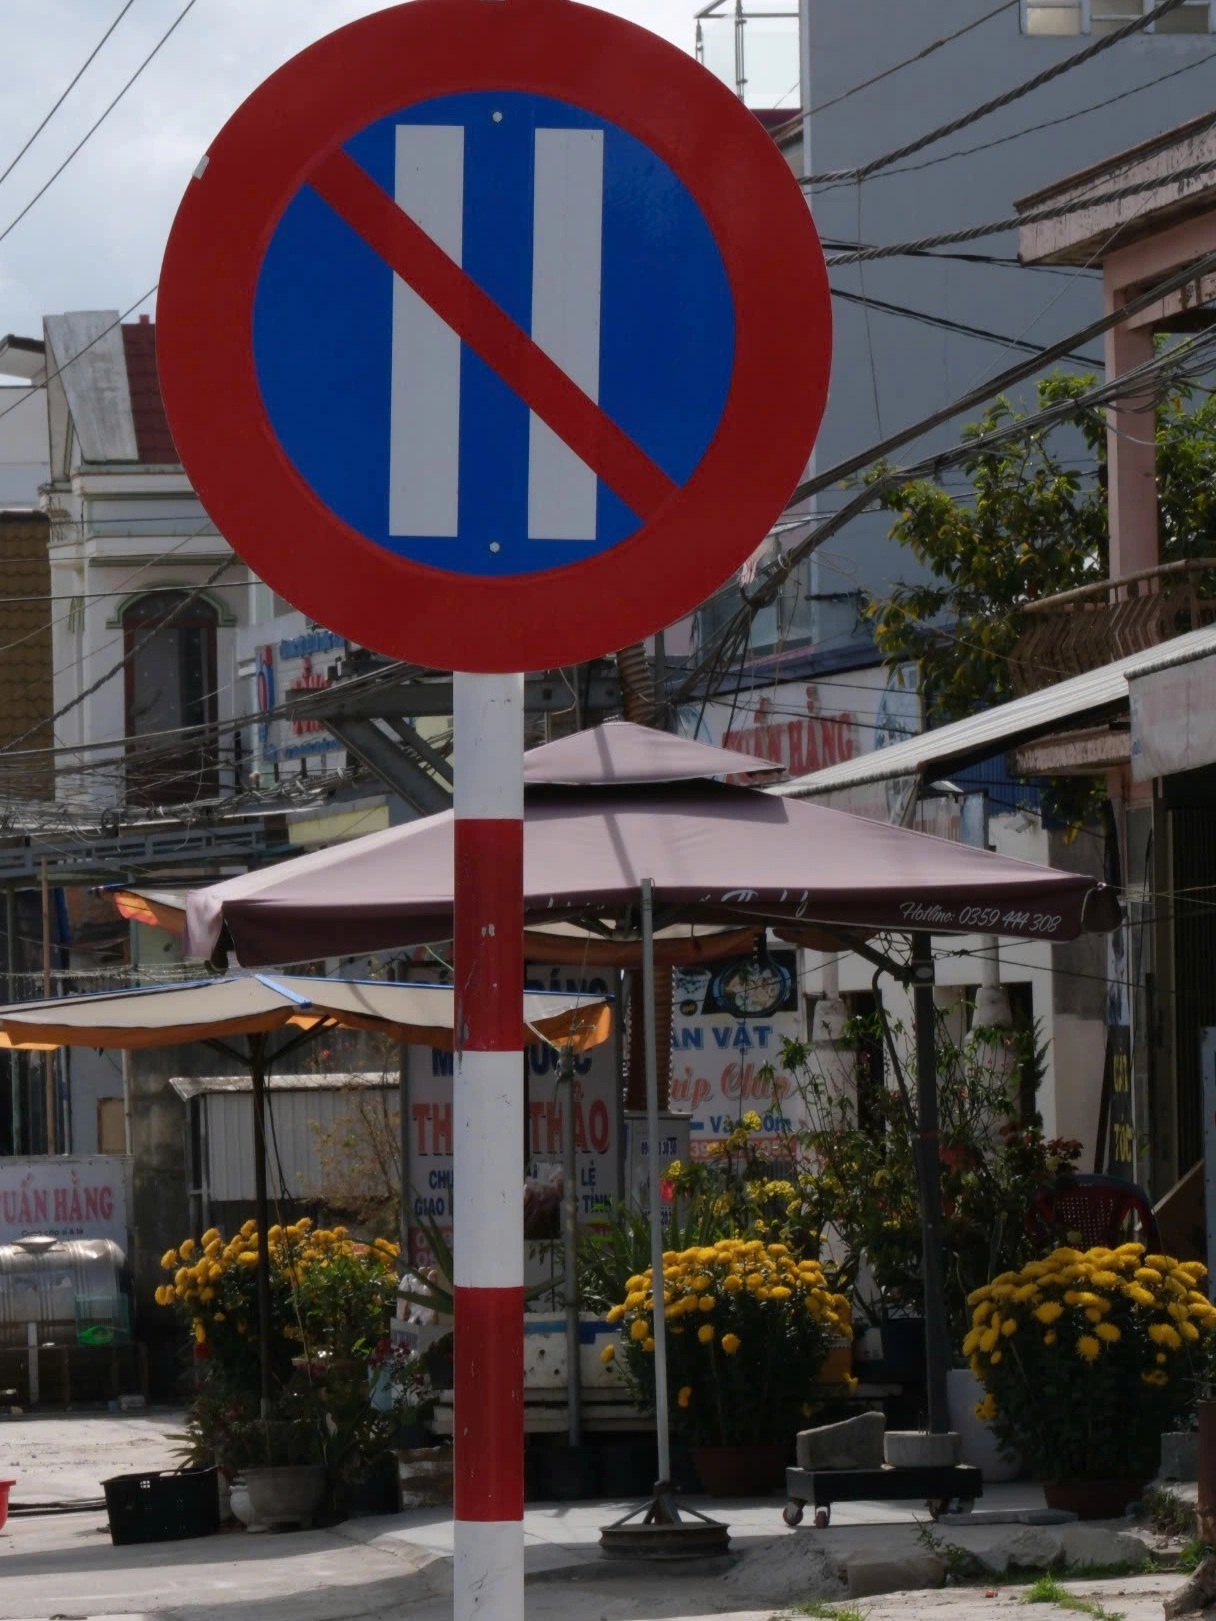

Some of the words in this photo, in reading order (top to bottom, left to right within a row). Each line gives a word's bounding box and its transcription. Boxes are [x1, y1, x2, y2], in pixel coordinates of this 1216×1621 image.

[958, 906, 1000, 927] 0359
[1001, 910, 1028, 929] 444
[1029, 913, 1062, 933] 308
